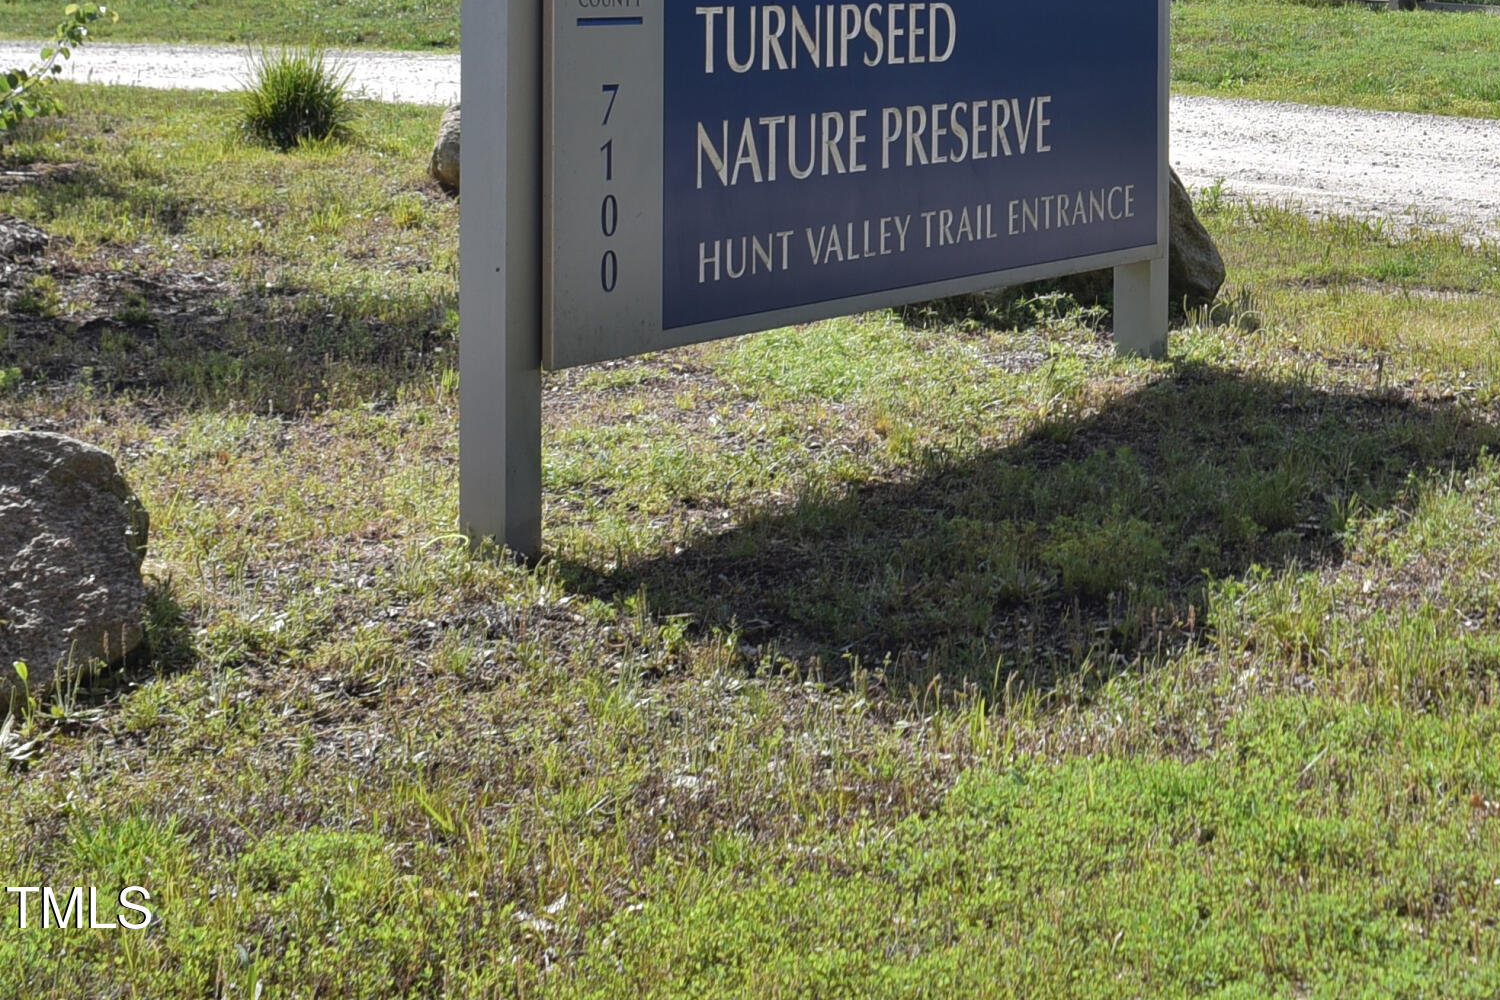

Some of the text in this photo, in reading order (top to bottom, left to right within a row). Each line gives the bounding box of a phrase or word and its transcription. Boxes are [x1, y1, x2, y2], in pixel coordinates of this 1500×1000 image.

[695, 2, 957, 74] TURNIPSEED
[599, 83, 620, 294] 7100
[696, 95, 1052, 189] NATURE PRESERVE
[698, 184, 1136, 283] HUNT VALLEY TRAIL ENTRANCE
